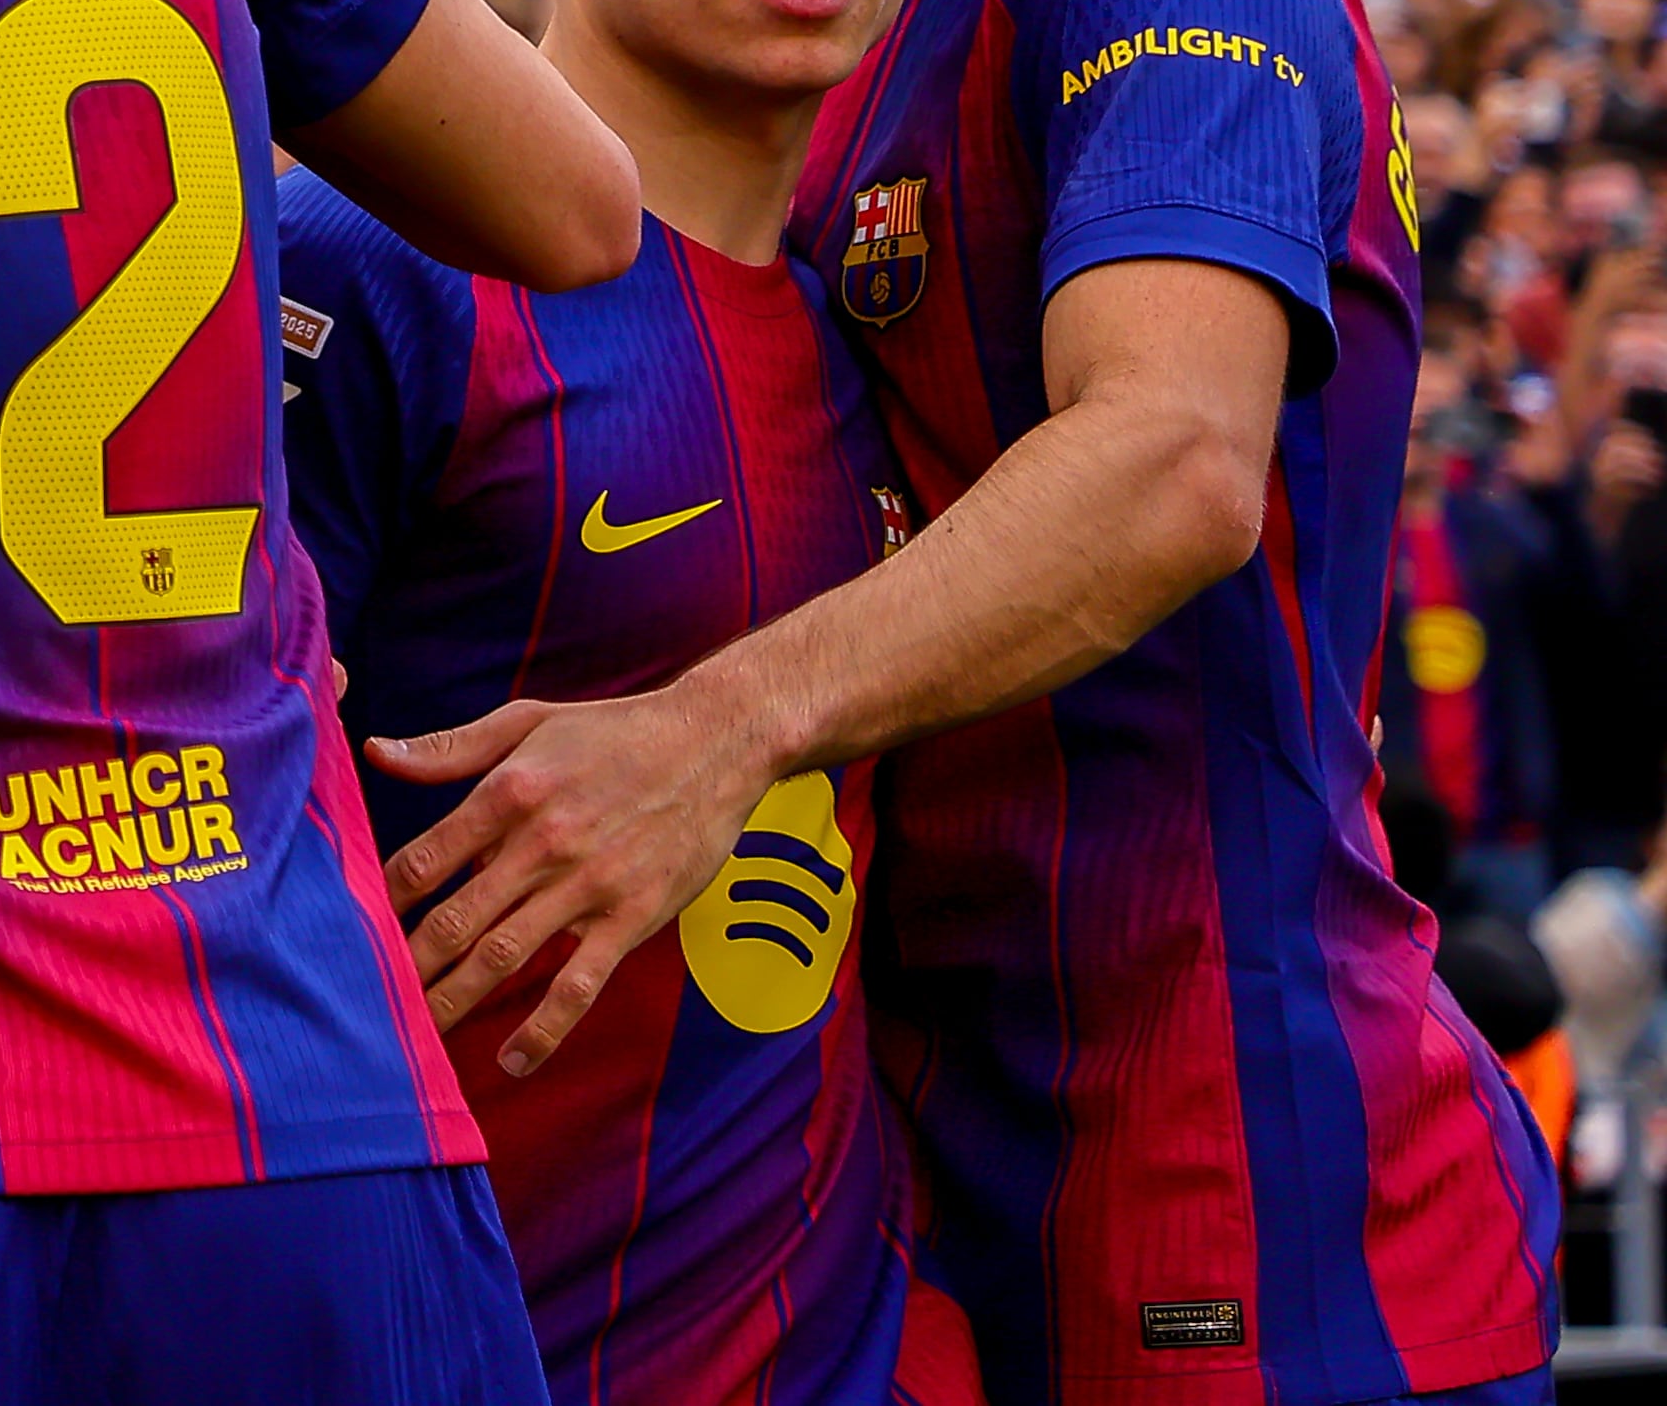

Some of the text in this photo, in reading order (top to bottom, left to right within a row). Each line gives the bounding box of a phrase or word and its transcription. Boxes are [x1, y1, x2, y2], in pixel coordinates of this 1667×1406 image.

[1062, 27, 1305, 105] AMBILIGHT tv
[867, 239, 900, 261] FCB
[280, 313, 317, 340] 2025
[0, 802, 242, 880] ACNUR
[8, 855, 248, 894] The UN Refugee Agency
